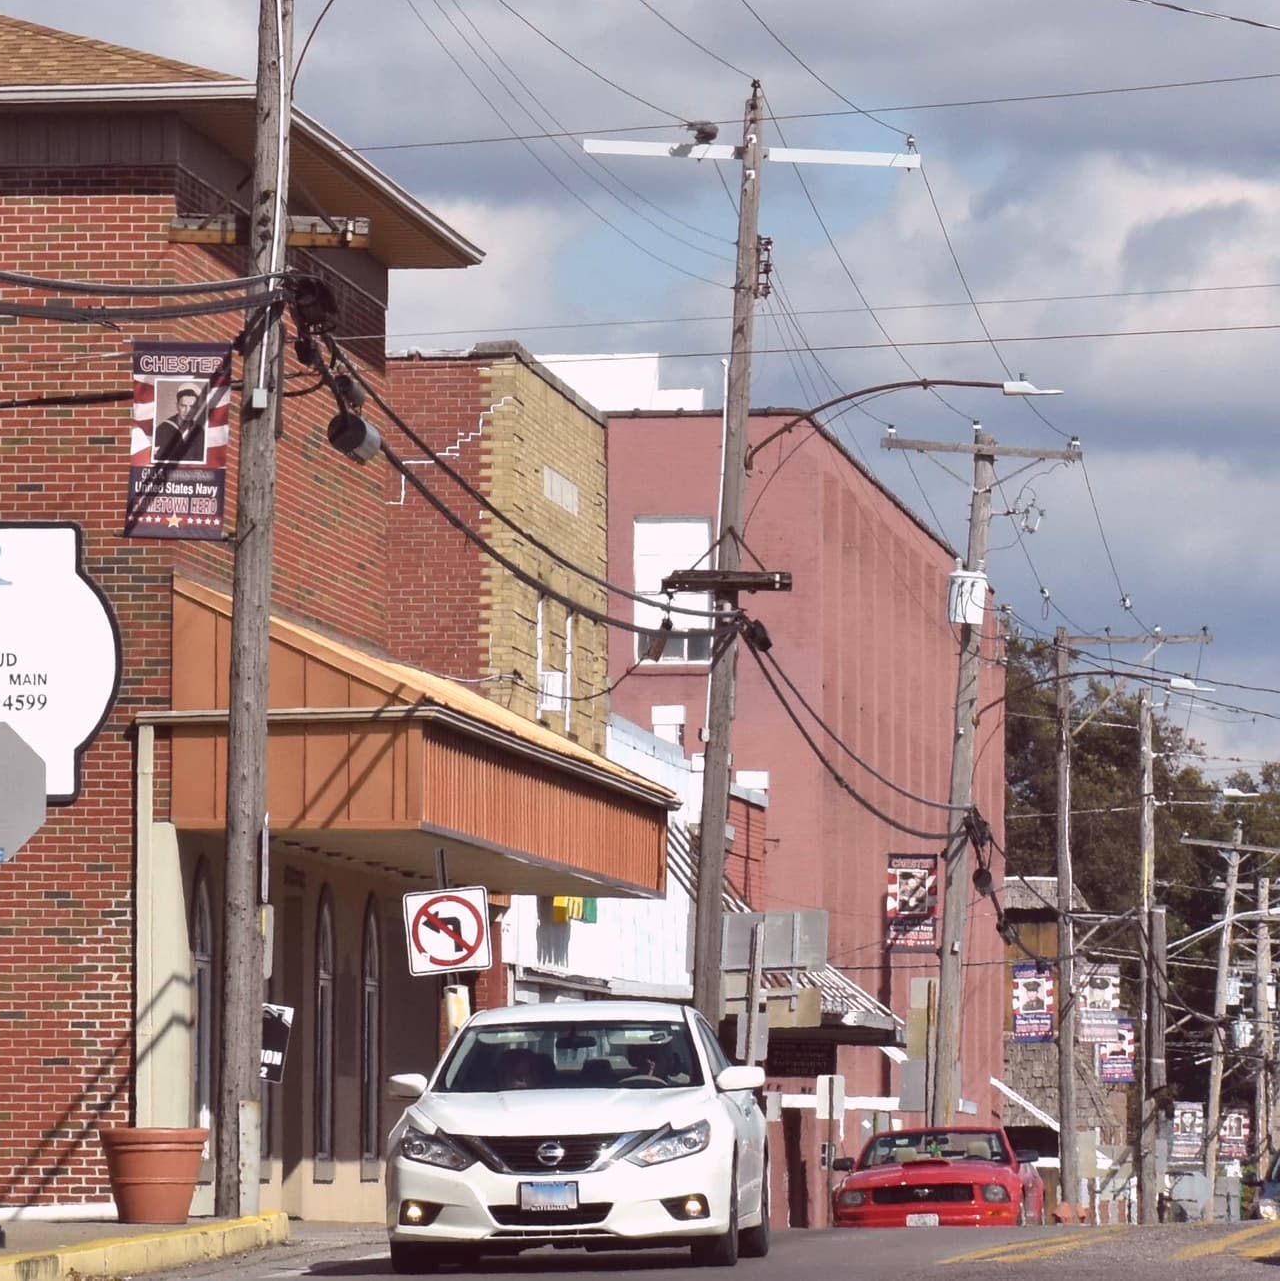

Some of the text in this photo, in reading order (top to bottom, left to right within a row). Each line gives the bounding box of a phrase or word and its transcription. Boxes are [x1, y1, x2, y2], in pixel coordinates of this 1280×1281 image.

[135, 481, 218, 497] United States Navy
[133, 495, 218, 515] METOWN HERO
[9, 673, 48, 687] MAIN
